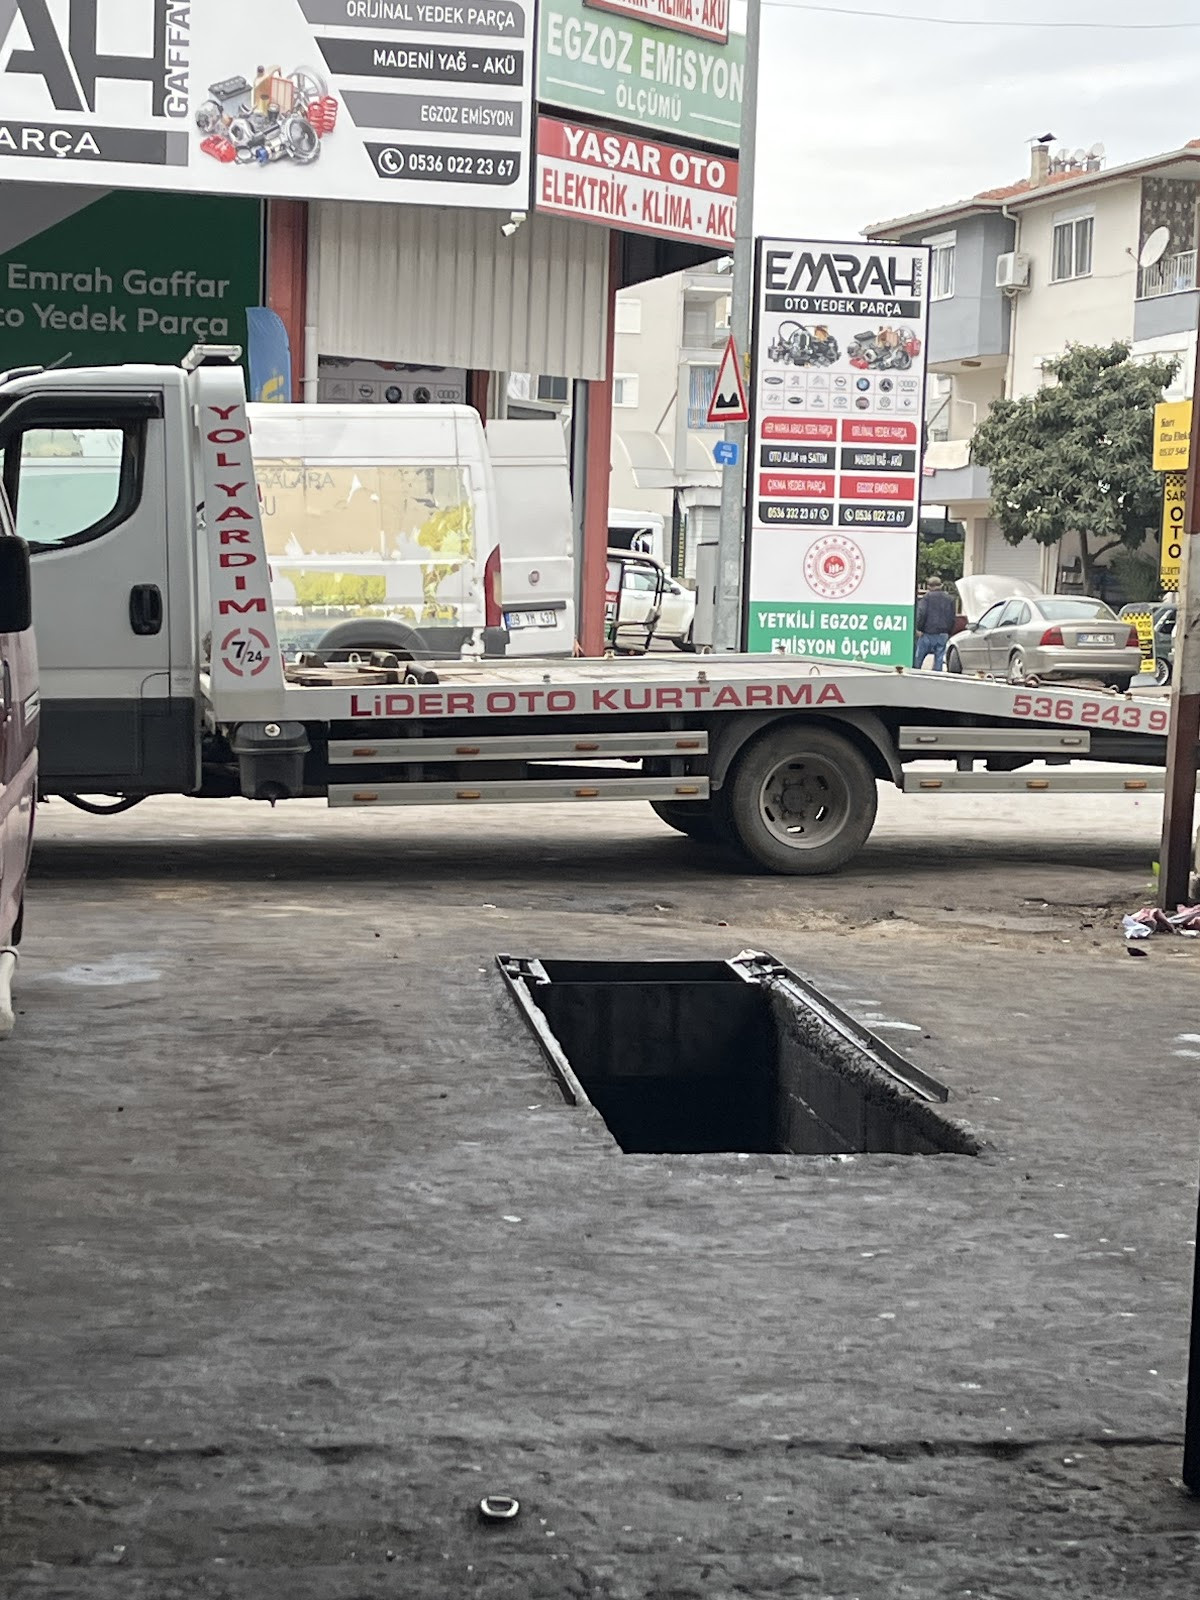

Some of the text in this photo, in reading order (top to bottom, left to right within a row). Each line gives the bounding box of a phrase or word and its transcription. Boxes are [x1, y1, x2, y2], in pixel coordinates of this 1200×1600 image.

[416, 5, 464, 24] YEDEK
[467, 8, 516, 31] PARÇA
[547, 12, 633, 74] EGZOZ
[166, 0, 192, 118] GAFFA
[373, 49, 434, 70] MADENİ
[437, 51, 467, 72] YAĞ
[483, 55, 516, 75] AKÜ
[616, 79, 682, 122] ÖLÇÜMÜ
[420, 105, 514, 126] EGZOZ EMİSYON
[408, 153, 514, 177] 0536 022 23 67
[563, 126, 726, 189] YAŞAR OTO
[542, 167, 628, 217] ELEKTRİK
[642, 185, 693, 230] KLİMA
[7, 263, 230, 298] Emrah Gaffar
[765, 250, 916, 297] EMRAH
[784, 297, 902, 317] OTO YEDEK PARÇA
[32, 302, 126, 332] Yedek
[137, 307, 229, 343] Parça
[207, 404, 246, 467] YOL
[768, 450, 782, 463] OTO
[767, 507, 785, 518] 0536
[800, 508, 809, 519] 23
[809, 508, 818, 520] 67
[854, 509, 905, 522] 0536 022 23 67
[1168, 506, 1184, 559] OTO
[214, 481, 267, 615] YARDIM
[757, 609, 907, 631] YETKİLİ EGZOZ GAZI
[231, 640, 263, 665] 7/24
[771, 635, 892, 658] EMİSYON ÖLÇÜM
[486, 690, 576, 714] OTO
[592, 683, 846, 710] KURTARMA
[1012, 694, 1074, 720] 536
